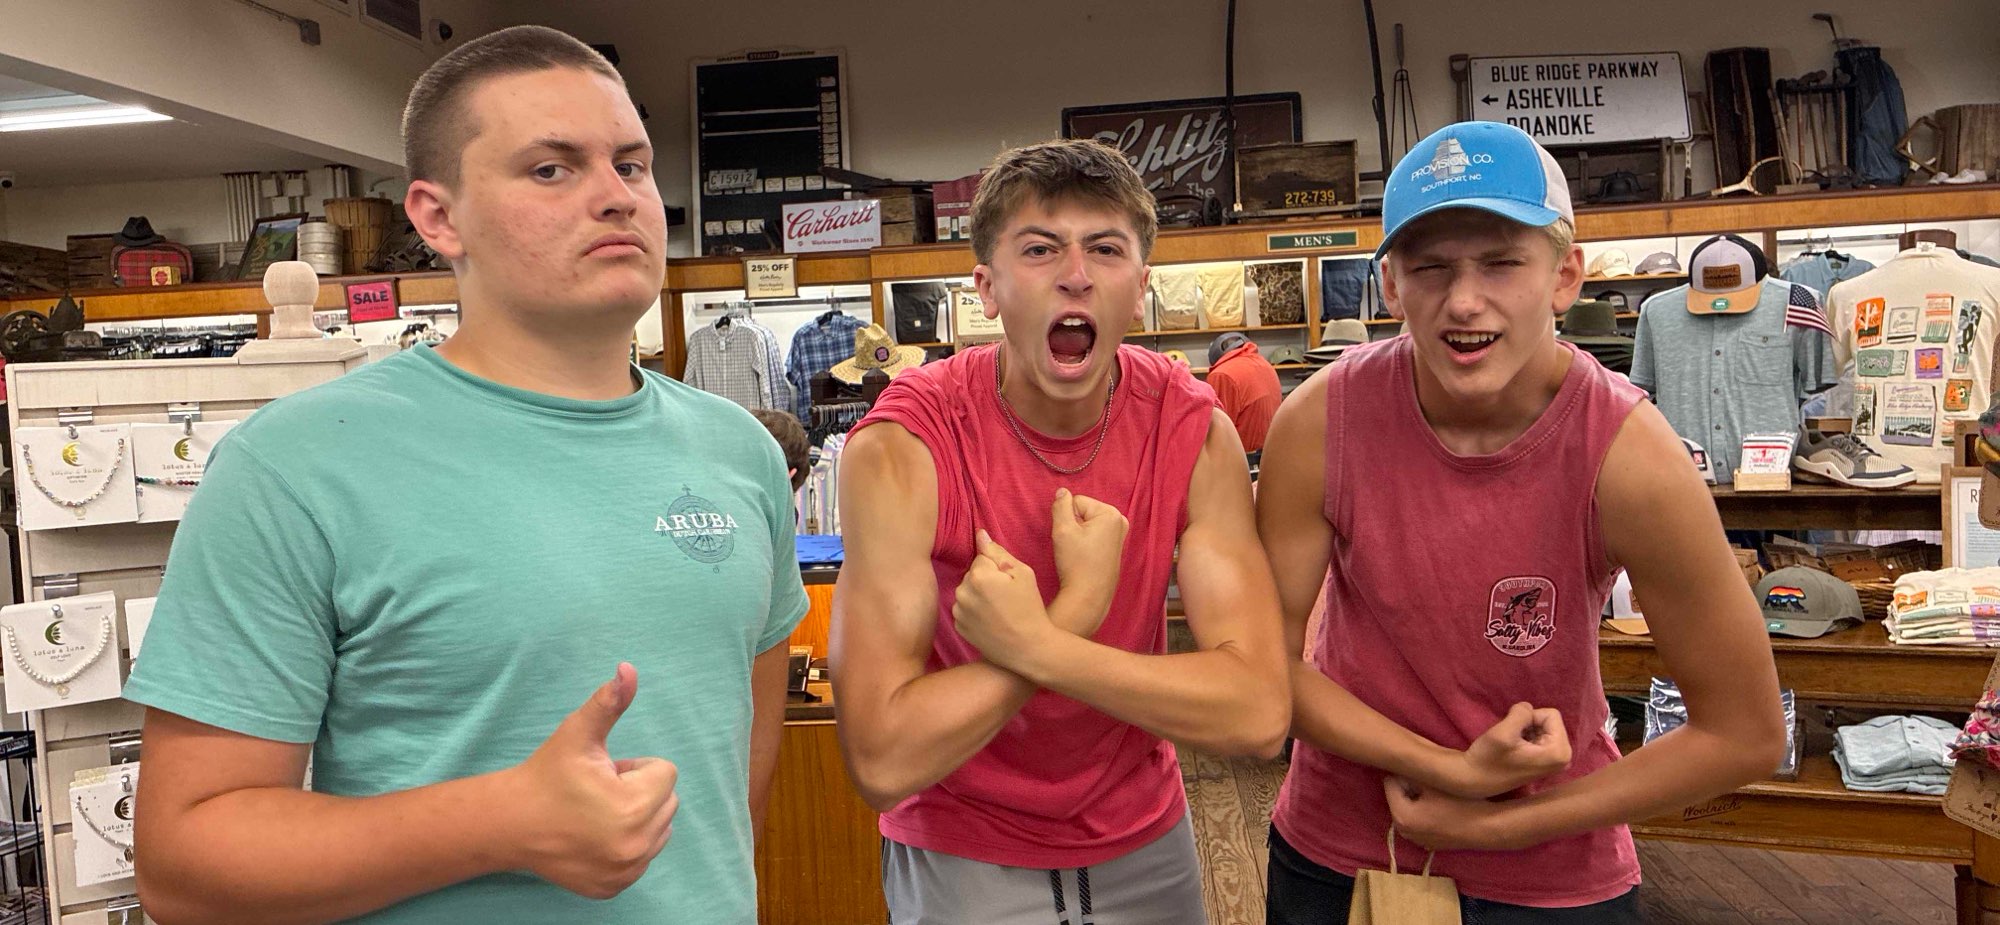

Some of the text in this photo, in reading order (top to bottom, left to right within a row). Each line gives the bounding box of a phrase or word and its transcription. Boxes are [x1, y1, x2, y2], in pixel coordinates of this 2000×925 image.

[1491, 61, 1659, 83] BLUE RIDGE PARKWAY
[1506, 86, 1605, 110] ASHEVILLE
[1411, 153, 1494, 182] PROVISION CO.
[787, 204, 878, 240] Carhartt
[1294, 235, 1333, 247] MEN'S
[771, 263, 789, 271] OFF
[353, 290, 389, 305] SALE
[655, 513, 739, 532] ARUBA
[1484, 614, 1556, 645] Salty Vibes
[103, 823, 124, 832] lotus
